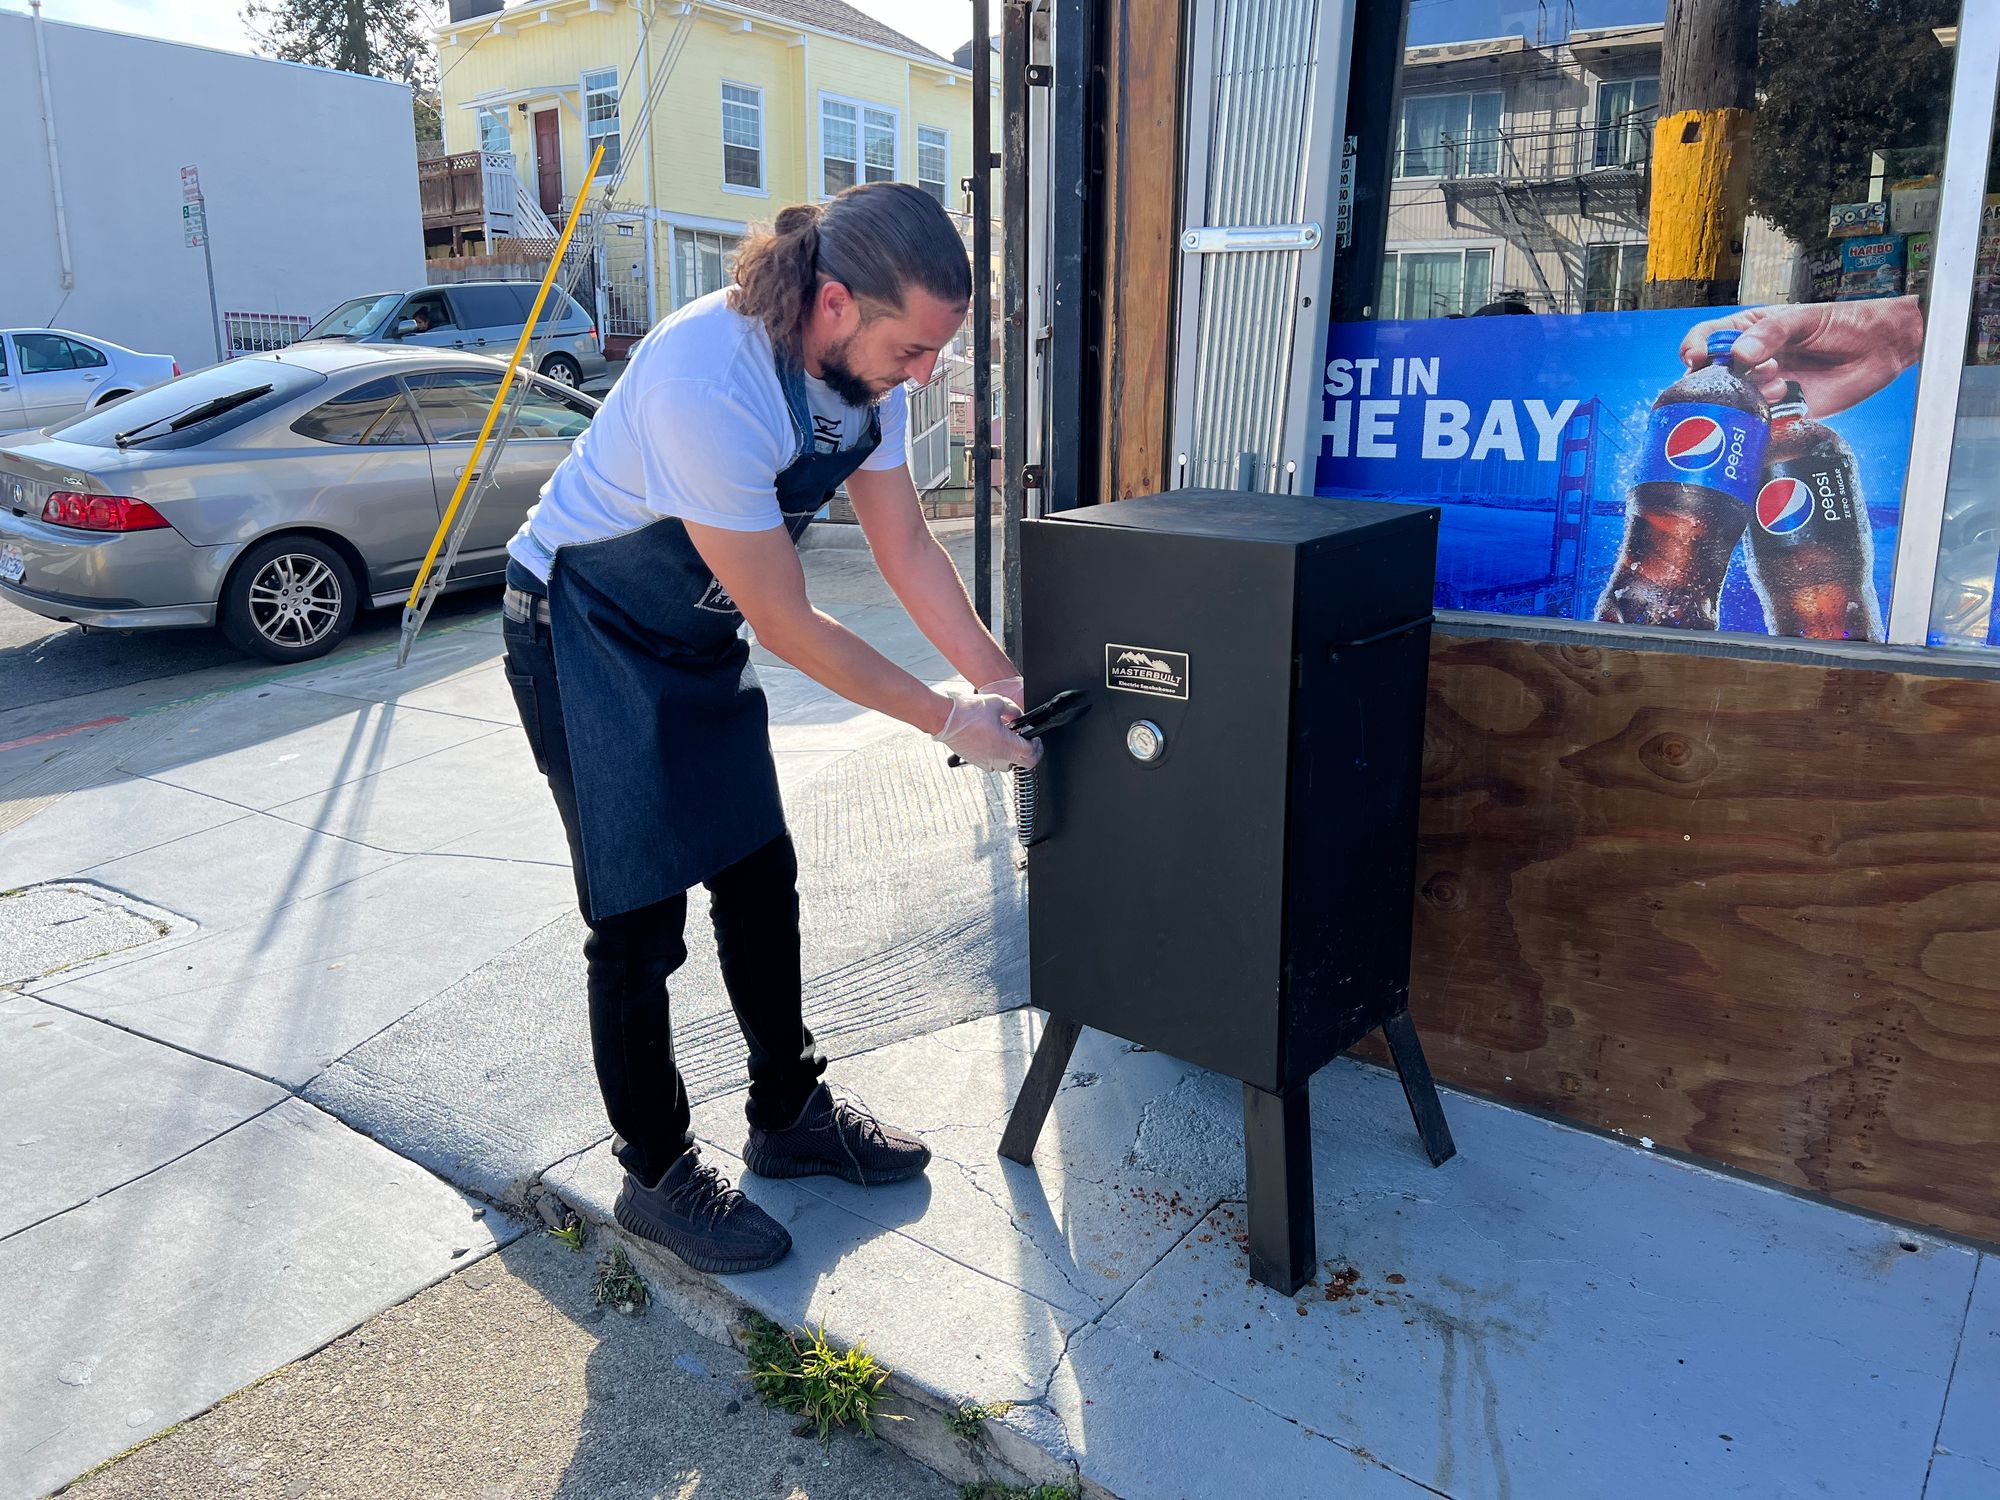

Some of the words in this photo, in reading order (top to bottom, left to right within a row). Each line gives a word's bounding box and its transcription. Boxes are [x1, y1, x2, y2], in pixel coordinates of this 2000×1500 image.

[1850, 243, 1894, 257] HARIBO
[1322, 359, 1379, 396] ST
[1391, 357, 1440, 395] IN
[1421, 400, 1580, 461] BAY
[1724, 426, 1746, 479] pepsi
[1812, 471, 1841, 521] pepsi
[1834, 468, 1846, 495] SUGAR
[1840, 497, 1851, 518] ZERO
[1112, 668, 1182, 683] MASTERBUILT
[1140, 684, 1175, 693] Smokehouse
